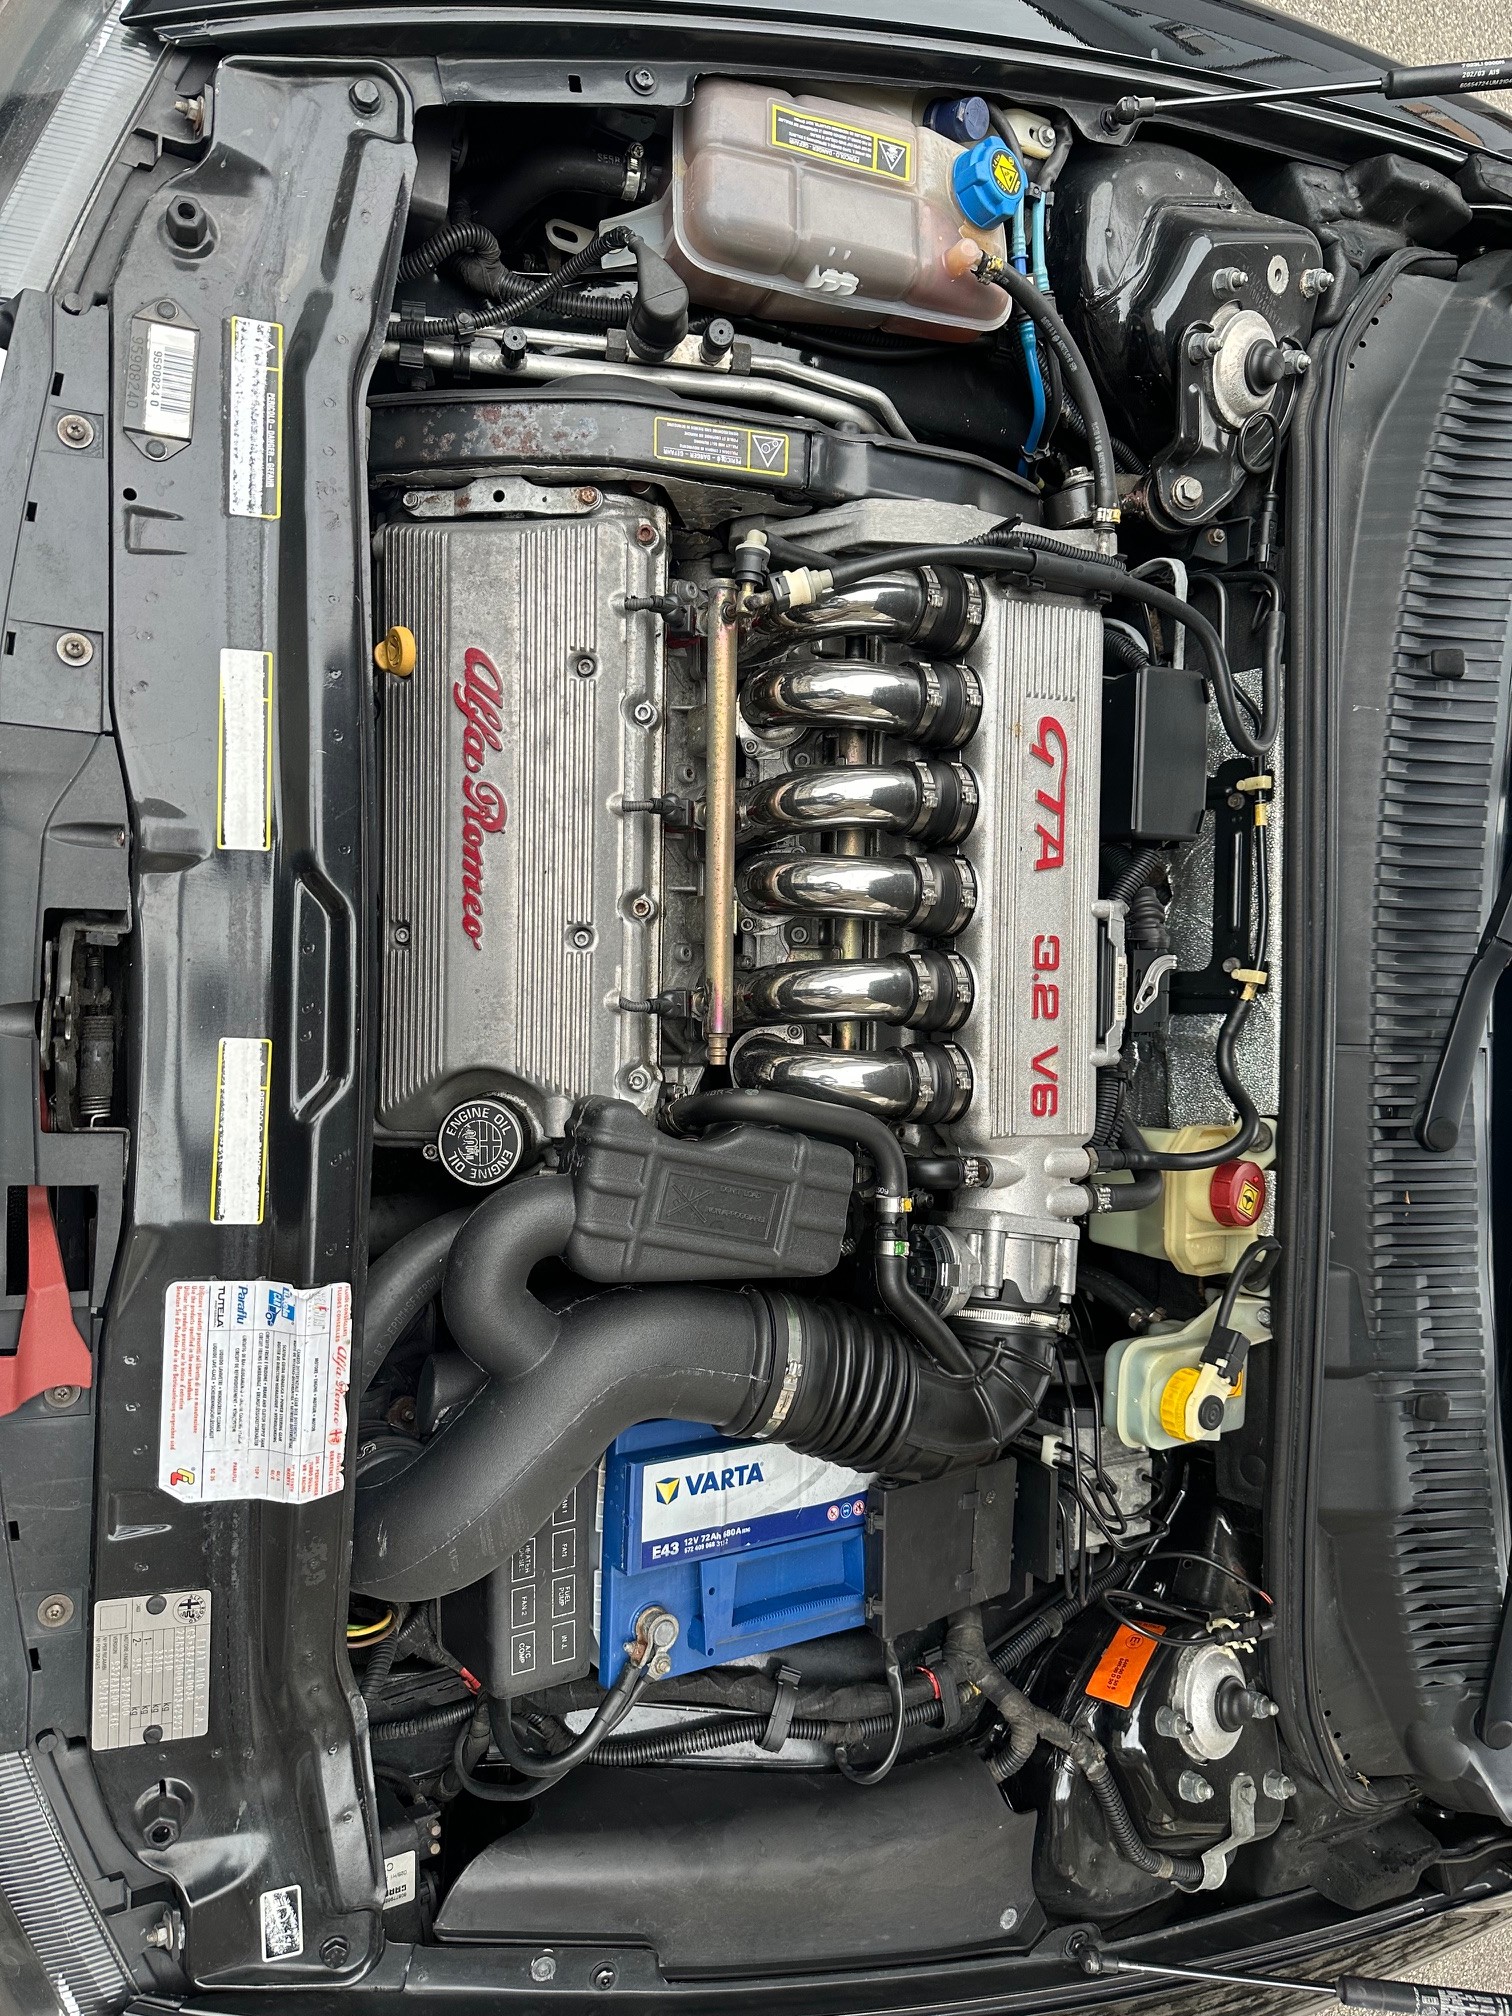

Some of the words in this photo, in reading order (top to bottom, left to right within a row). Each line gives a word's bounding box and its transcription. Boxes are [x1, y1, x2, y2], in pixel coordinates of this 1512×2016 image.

[126, 336, 144, 409] 95908240
[150, 351, 162, 396] 9590824
[266, 430, 275, 457] DANGER
[453, 647, 505, 772] Alfa
[1029, 716, 1068, 872] GTA
[460, 773, 508, 952] Romeo
[1031, 934, 1061, 1020] 3.2
[1030, 1045, 1060, 1118] V6
[446, 1107, 490, 1136] ENGINE
[494, 1114, 511, 1135] OIL
[448, 1151, 466, 1173] OIL
[469, 1150, 513, 1179] ENGINE
[236, 1285, 249, 1324] Paraflu
[332, 1346, 348, 1378] Alfa
[685, 1462, 764, 1496] VARTA
[652, 1541, 680, 1560] E43
[684, 1536, 699, 1546] 12V
[701, 1532, 722, 1542] 72Ah
[130, 1707, 139, 1716] kg
[141, 1705, 150, 1714] kg
[152, 1704, 160, 1712] kg
[162, 1702, 172, 1711] kg
